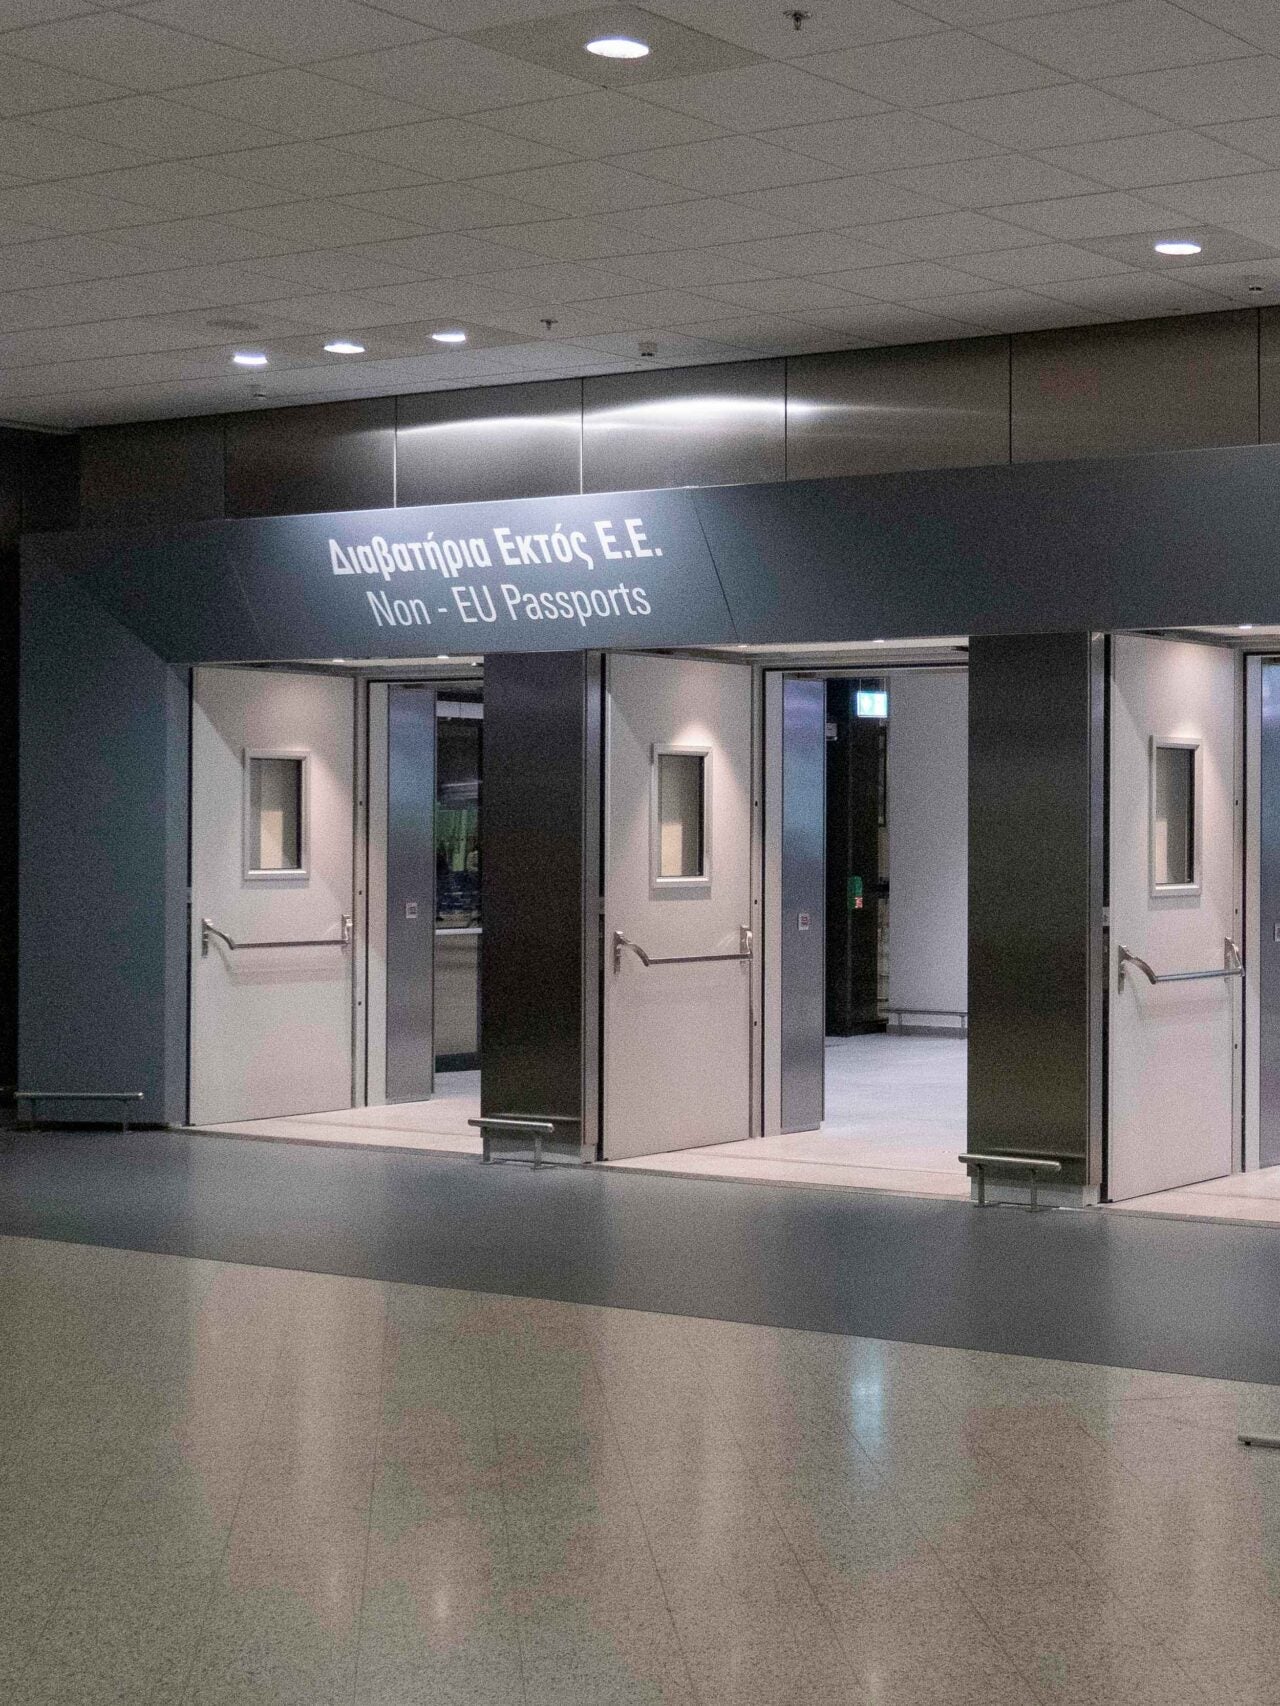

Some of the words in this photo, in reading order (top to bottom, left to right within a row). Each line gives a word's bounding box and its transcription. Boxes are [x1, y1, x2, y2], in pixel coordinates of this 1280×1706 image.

[328, 532, 492, 581] Διαβατήρια
[493, 523, 594, 570] Εκτός
[367, 591, 431, 627] Non
[451, 586, 498, 623] EU
[501, 582, 651, 627] Passports
